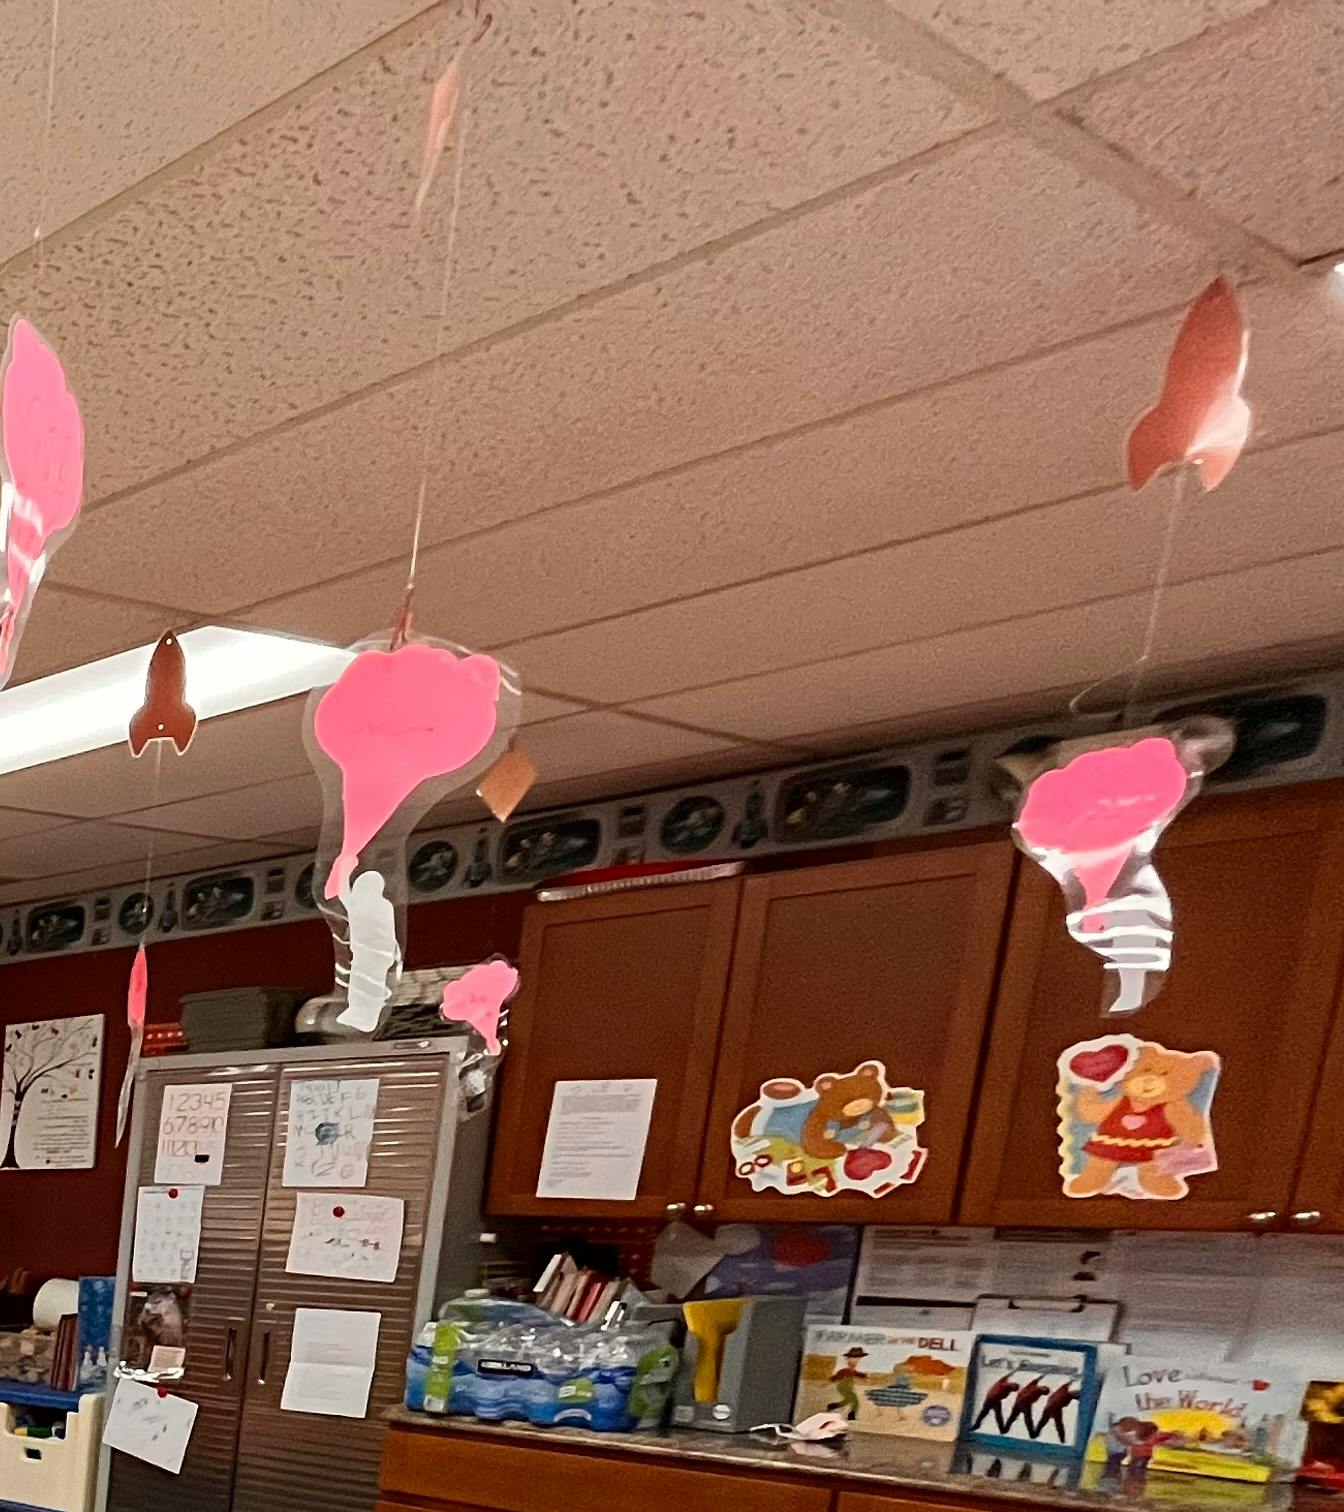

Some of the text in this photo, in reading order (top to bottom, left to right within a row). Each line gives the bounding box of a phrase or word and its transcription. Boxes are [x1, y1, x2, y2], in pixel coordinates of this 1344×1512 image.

[917, 1336, 959, 1351] DELL
[1123, 1365, 1182, 1387] Love
[1134, 1389, 1248, 1417] the World
